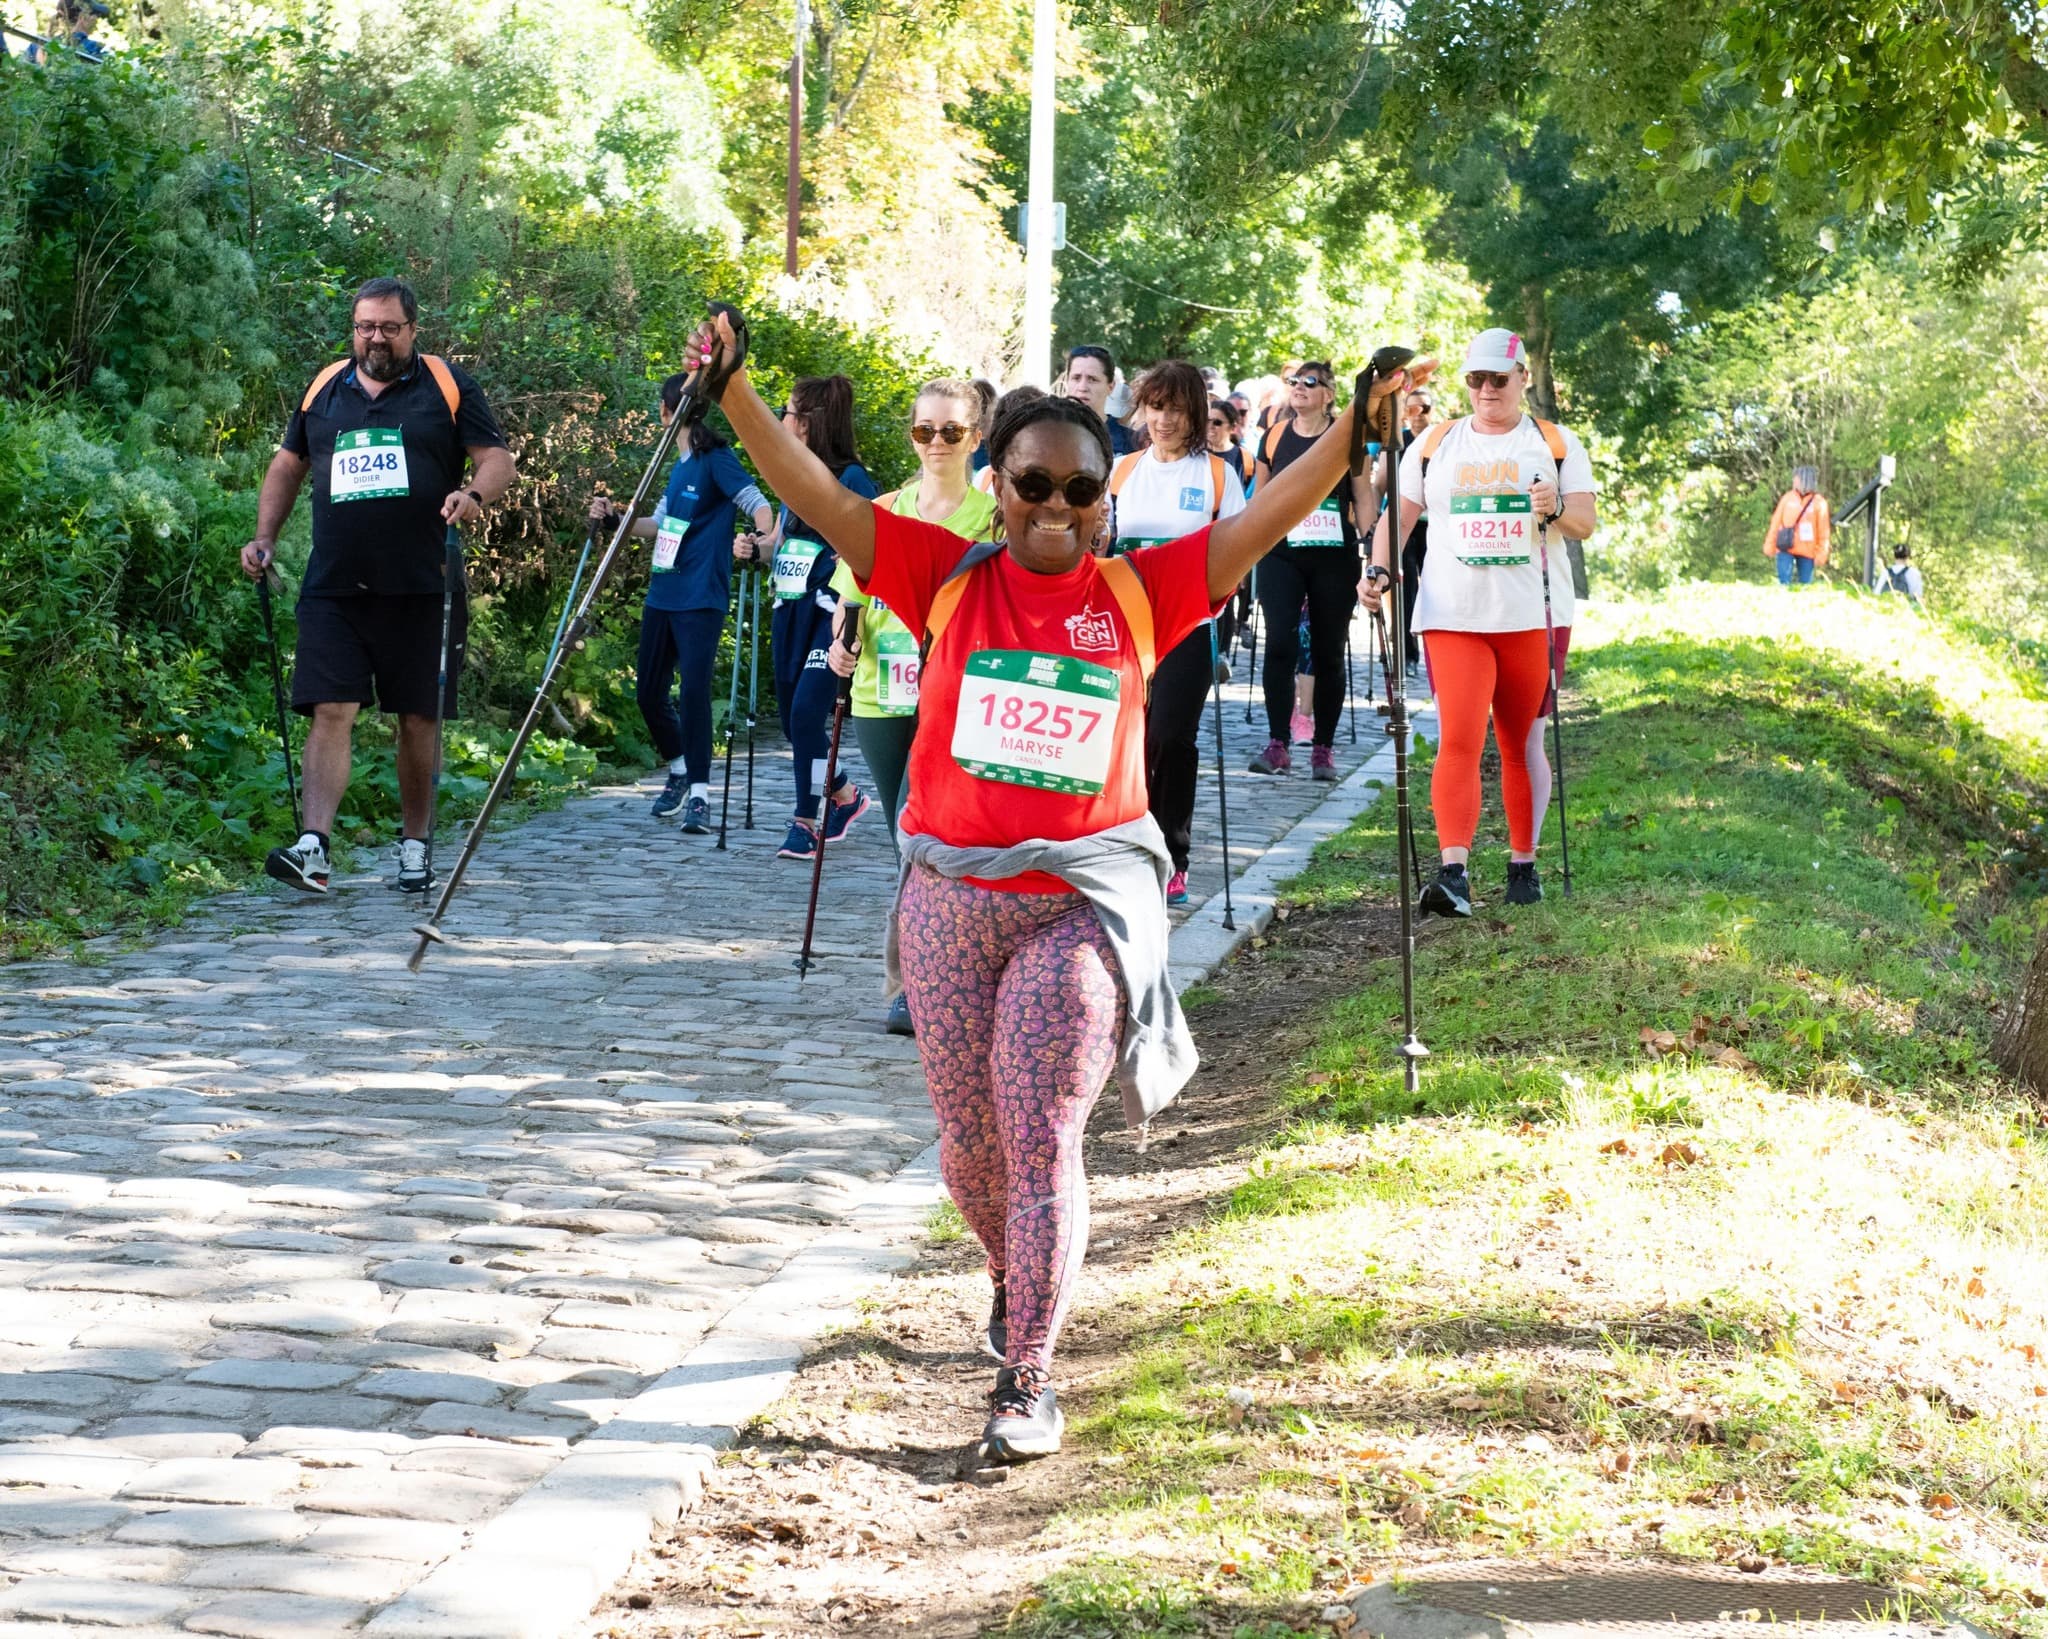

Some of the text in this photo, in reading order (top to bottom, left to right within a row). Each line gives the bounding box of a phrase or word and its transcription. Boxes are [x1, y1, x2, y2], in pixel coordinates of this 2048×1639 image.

[338, 453, 398, 475] 18248
[353, 474, 381, 484] DIDIER
[1456, 460, 1519, 486] RUN
[1297, 515, 1337, 528] 8014
[1459, 520, 1524, 539] 18214
[1468, 541, 1512, 550] CAROLINE
[776, 560, 810, 577] 16260
[1077, 628, 1111, 643] CEN
[979, 693, 1102, 744] 18257
[1000, 736, 1064, 759] MARYSE
[1014, 755, 1044, 766] CANCEN
